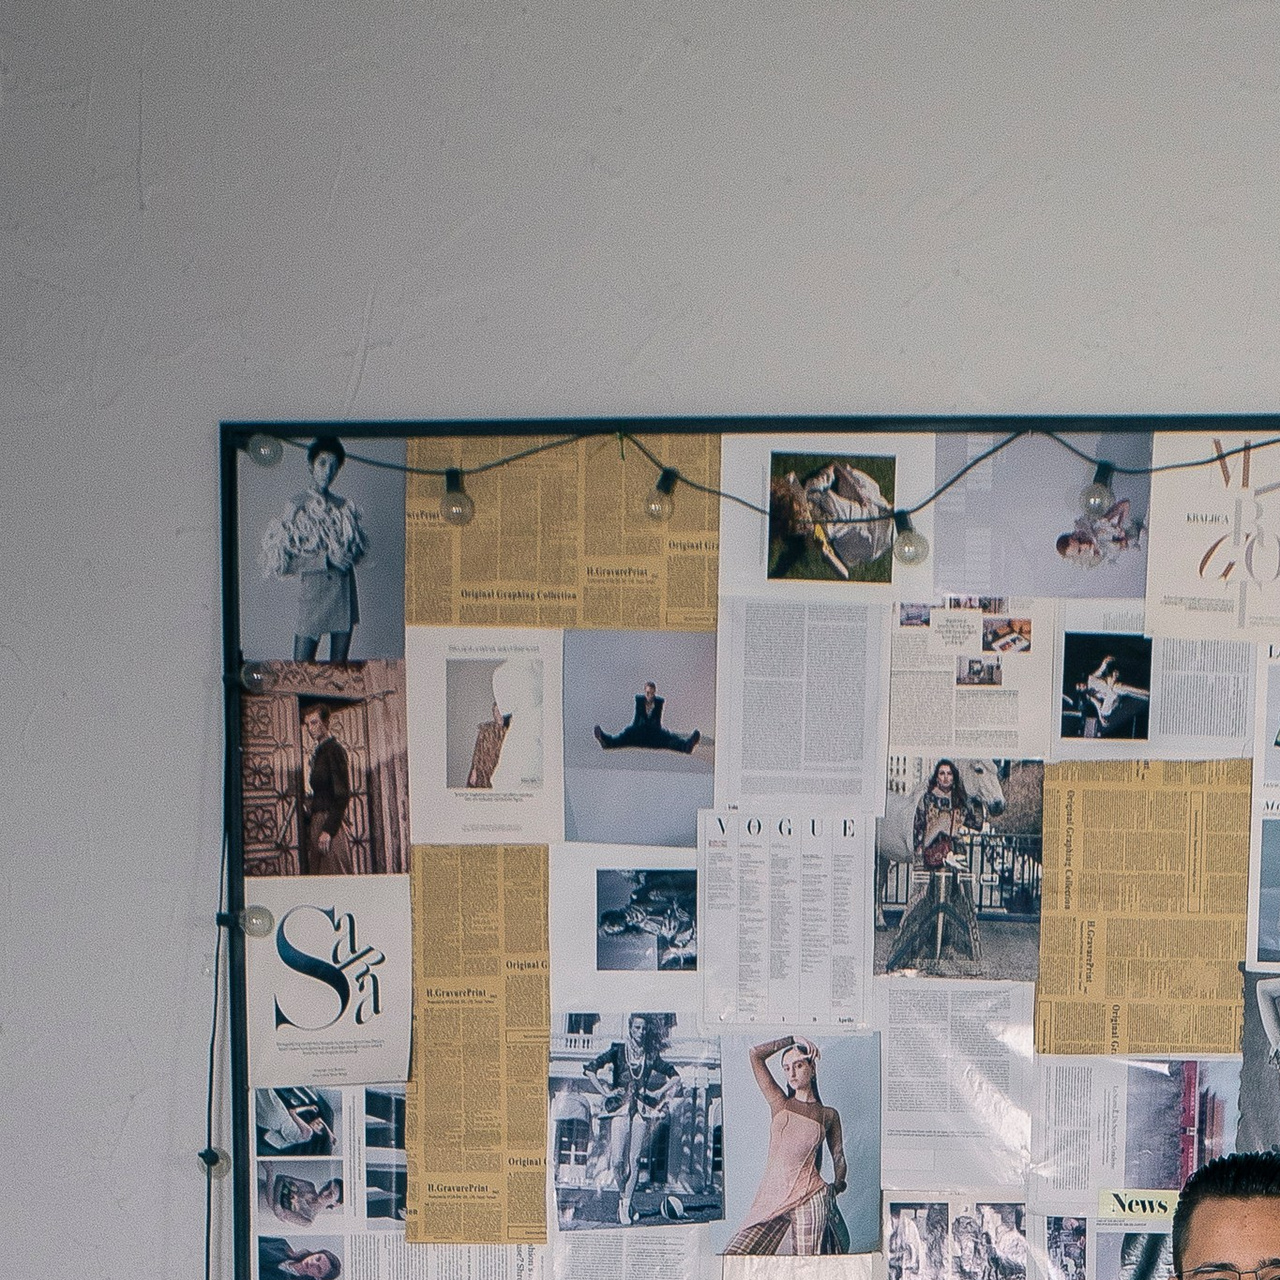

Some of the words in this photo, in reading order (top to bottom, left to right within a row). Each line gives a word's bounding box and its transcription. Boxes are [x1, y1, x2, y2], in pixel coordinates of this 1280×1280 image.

[716, 817, 856, 837] VOGUE
[505, 960, 539, 971] Original
[1110, 1004, 1120, 1038] Original
[508, 1157, 541, 1168] Original
[1111, 1192, 1169, 1214] News
